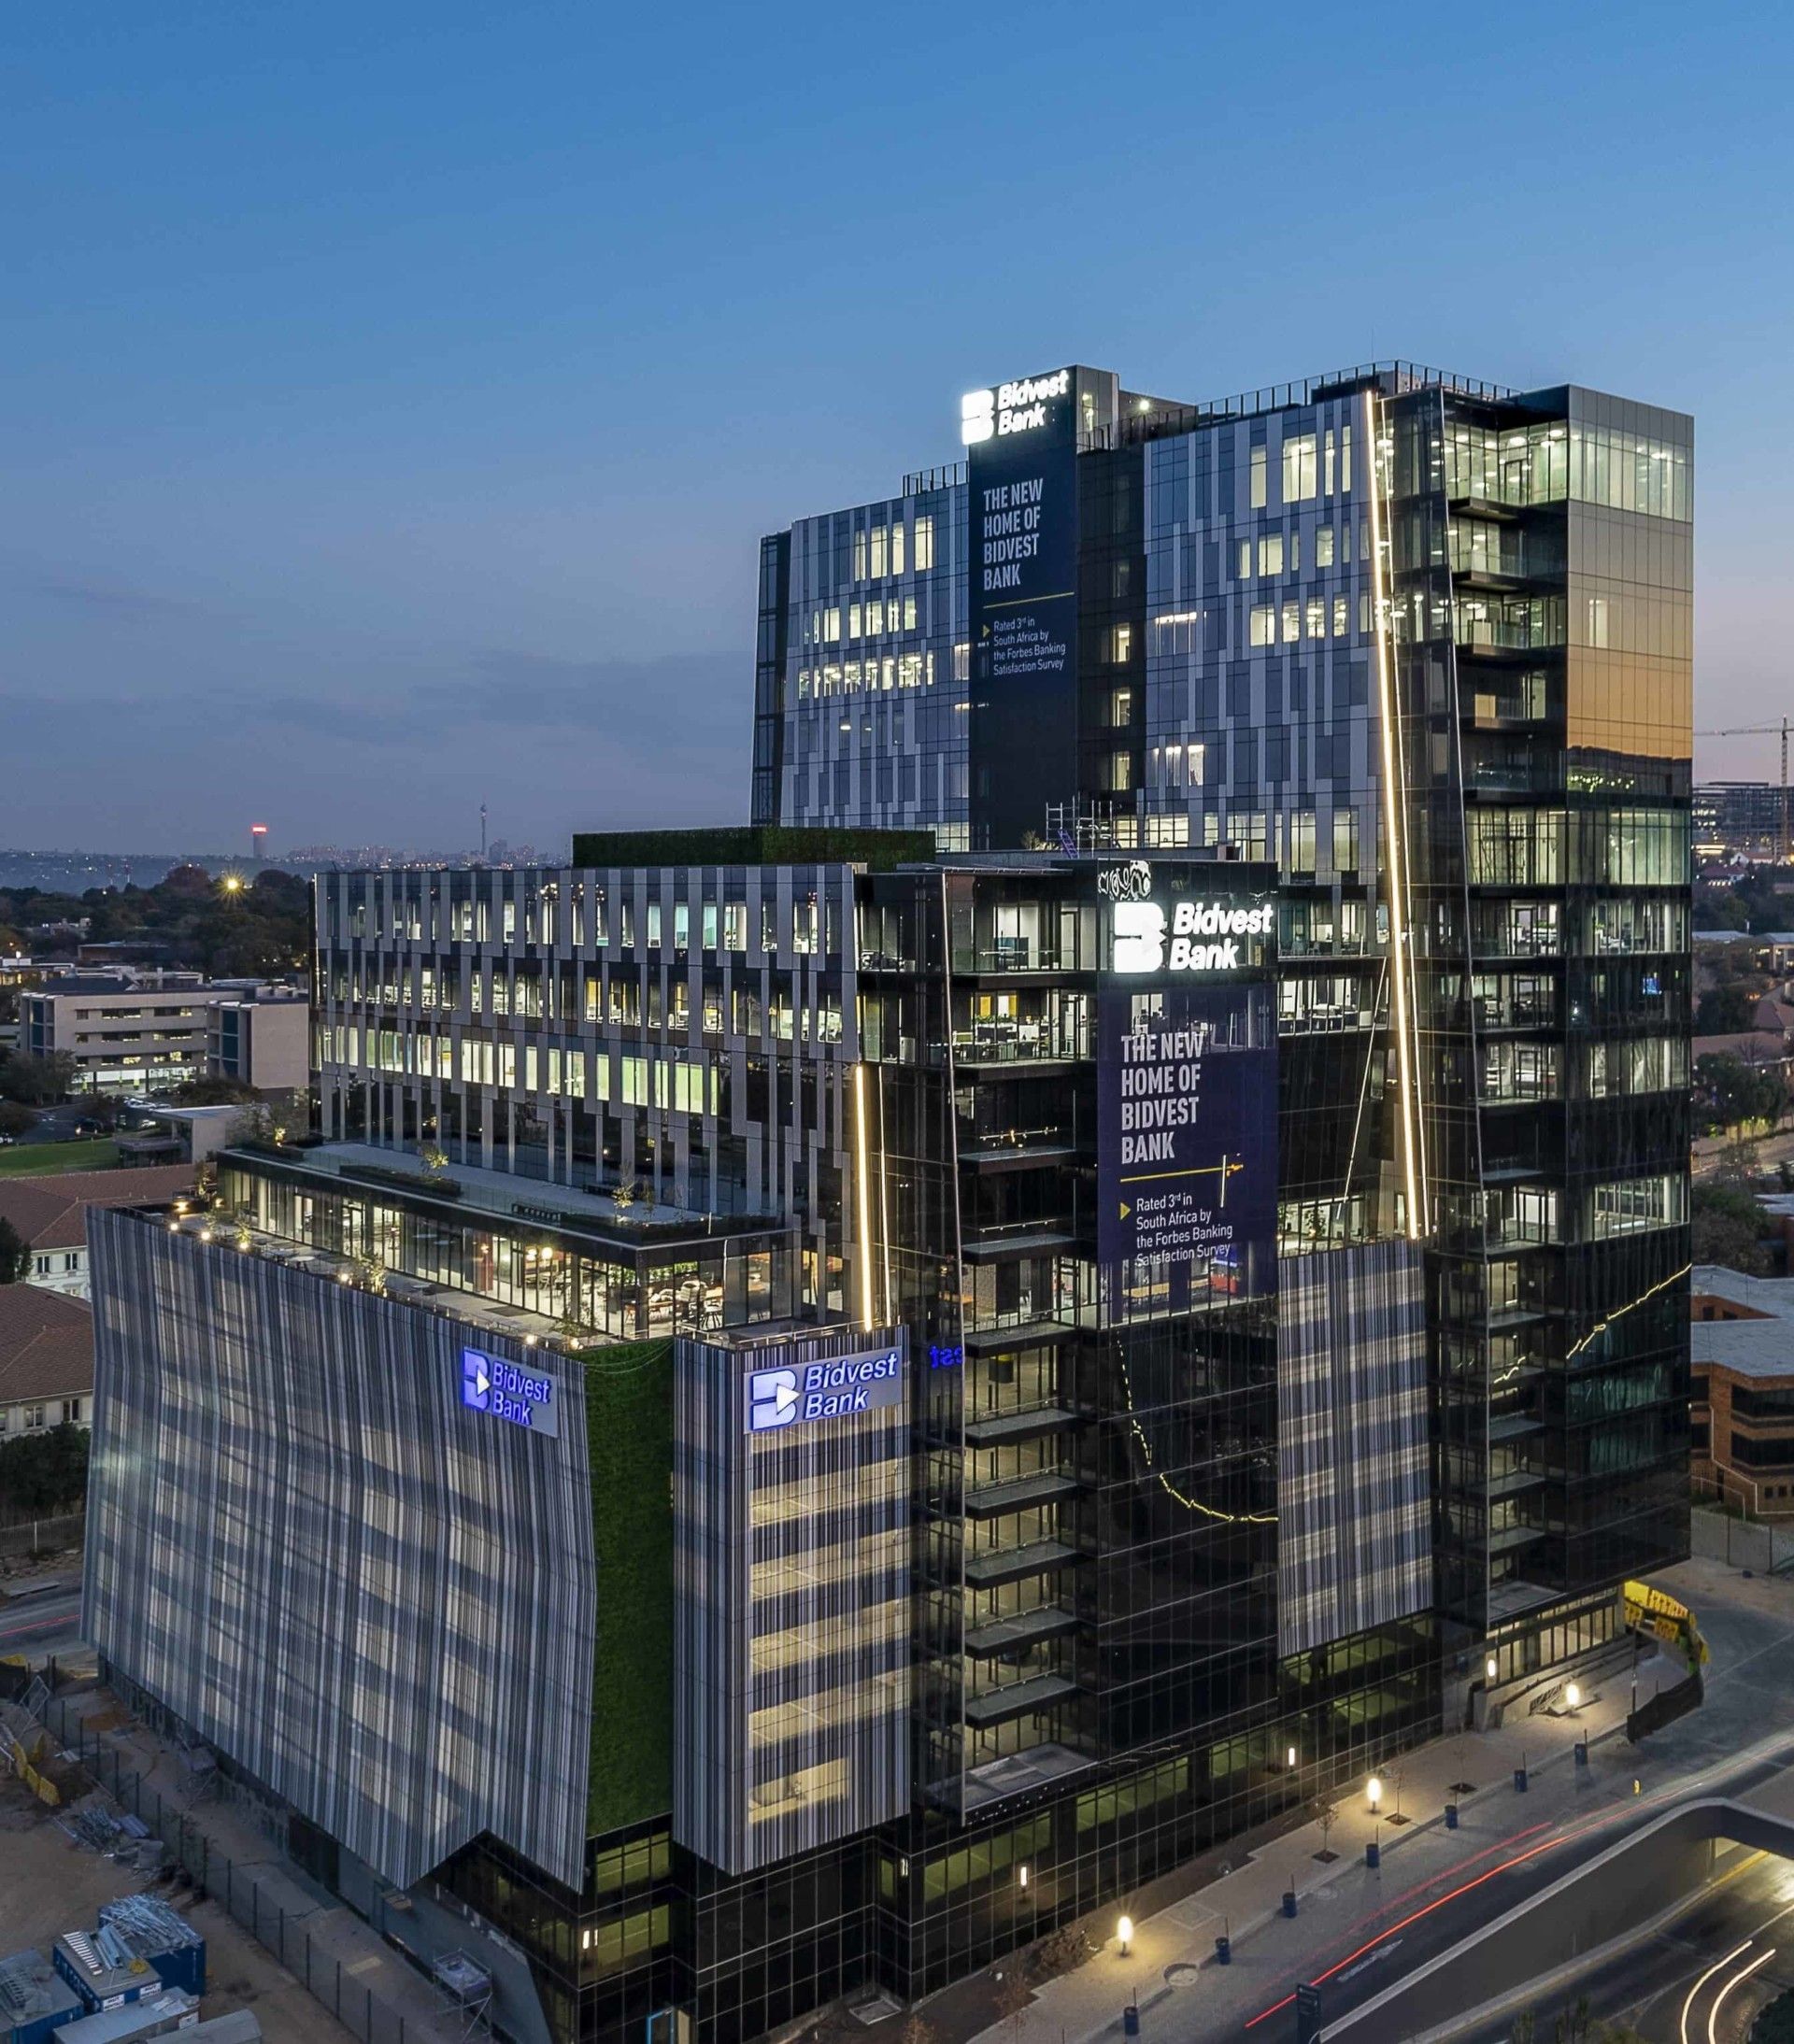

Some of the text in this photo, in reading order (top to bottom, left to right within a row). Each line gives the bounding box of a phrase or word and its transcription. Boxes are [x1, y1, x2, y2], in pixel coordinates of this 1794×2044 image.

[997, 370, 1069, 411] Bidvest
[997, 403, 1046, 435] Bank
[984, 477, 1044, 512] THE NEW
[984, 505, 1041, 538] HOME OF
[984, 532, 1040, 564] BIDVEST
[984, 562, 1021, 590] BANK
[993, 618, 1016, 632] Rated
[1028, 616, 1035, 627] in
[993, 629, 1049, 646] South Africa by
[993, 642, 1066, 661] the Forbes Banking
[993, 658, 1064, 675] Satisfaction Survey
[1173, 902, 1274, 935] Bidvest
[1169, 938, 1240, 971] Bank
[1121, 1030, 1204, 1063] THE NEW
[1121, 1063, 1201, 1097] HOME OF
[1121, 1096, 1200, 1131] BIDVEST
[1121, 1131, 1175, 1165] BANK
[1136, 1195, 1166, 1212] Rated
[1183, 1192, 1192, 1206] in
[1136, 1208, 1212, 1230] South Africa by
[1136, 1224, 1233, 1249] the Forbes Banking
[1136, 1242, 1231, 1267] Satisfaction Survey
[492, 1360, 549, 1404] Bidvest
[804, 1353, 898, 1393] Bidvest
[492, 1388, 532, 1426] Bank
[804, 1385, 869, 1421] Bank
